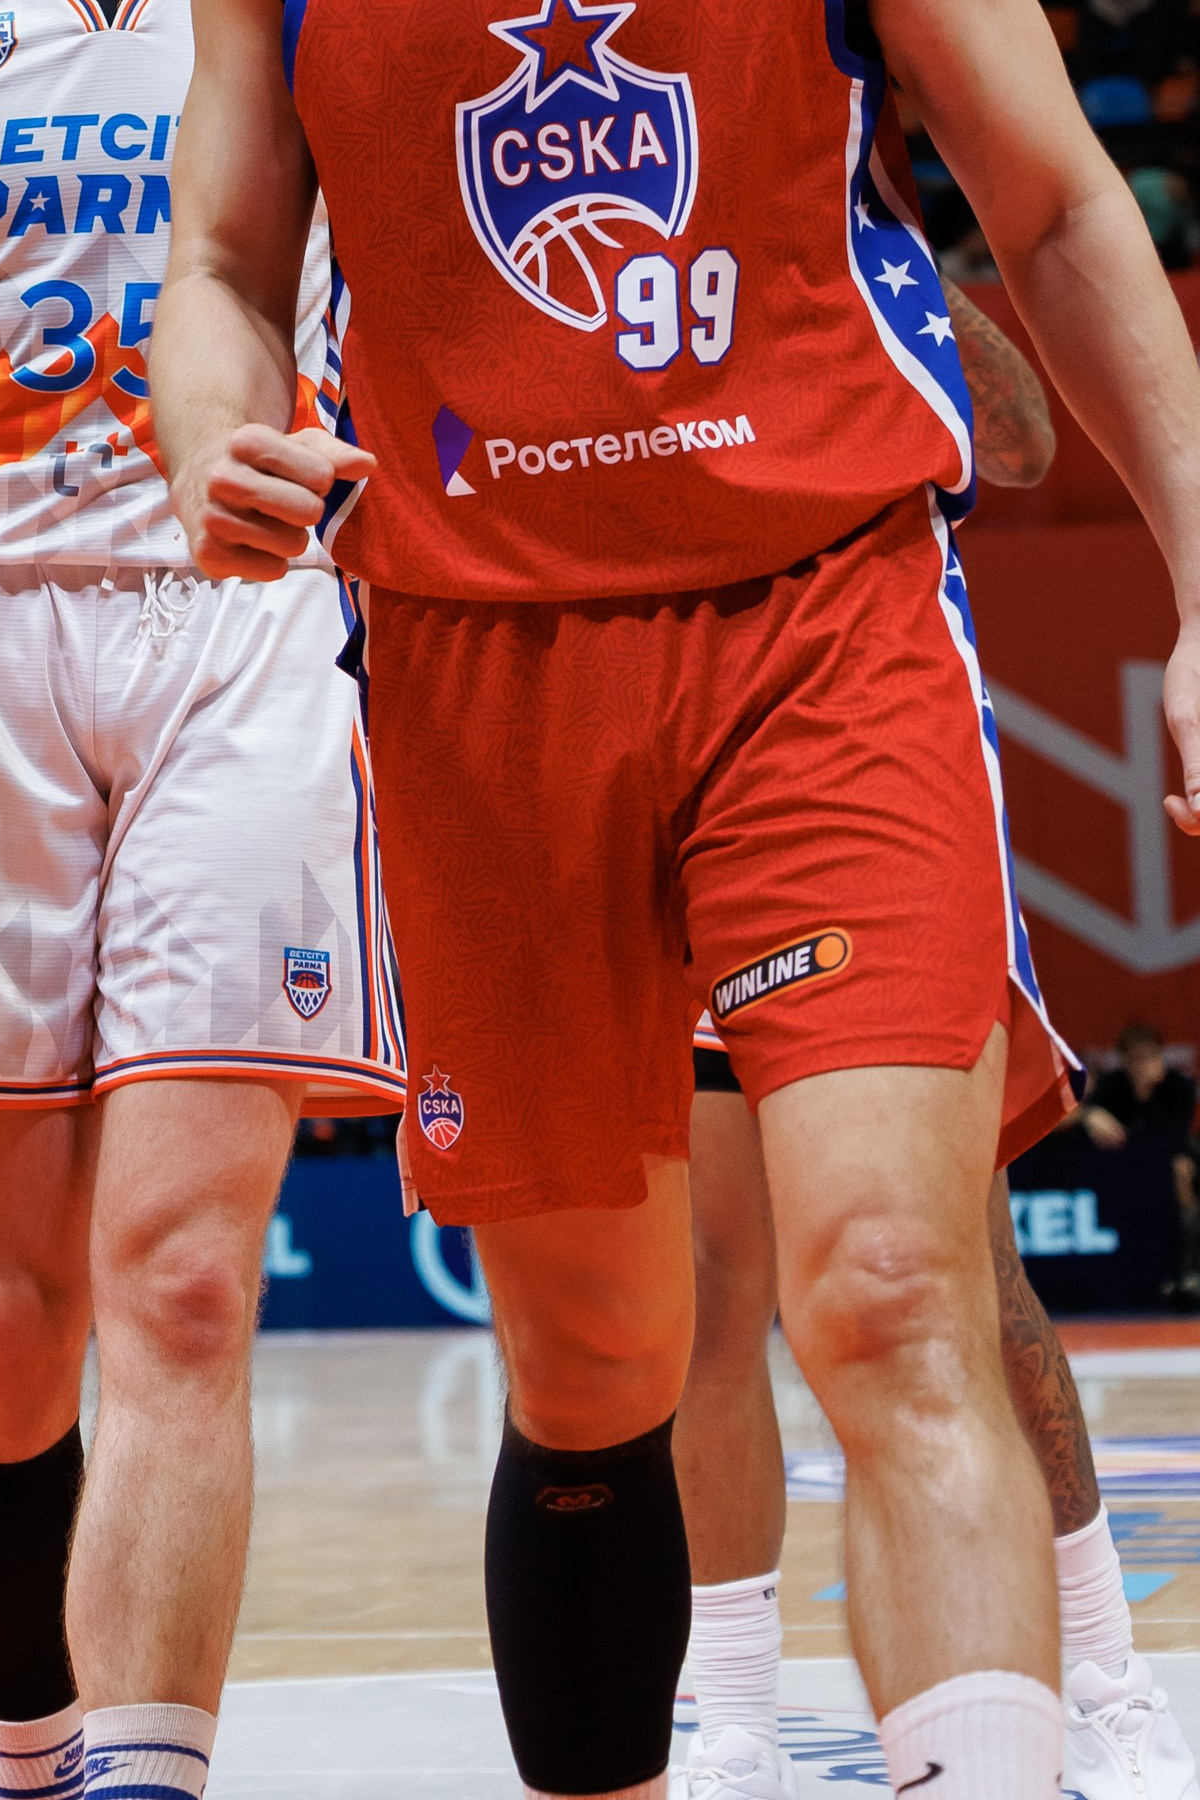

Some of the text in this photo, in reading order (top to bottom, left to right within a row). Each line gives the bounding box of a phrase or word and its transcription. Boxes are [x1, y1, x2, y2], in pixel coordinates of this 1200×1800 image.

[491, 111, 669, 187] CSKA
[614, 246, 741, 373] 99
[484, 413, 757, 480] Ростелеком
[289, 949, 326, 961] BETCITY
[293, 960, 322, 970] PARMA
[714, 945, 812, 1015] WINLINE
[422, 1099, 460, 1115] CSKA
